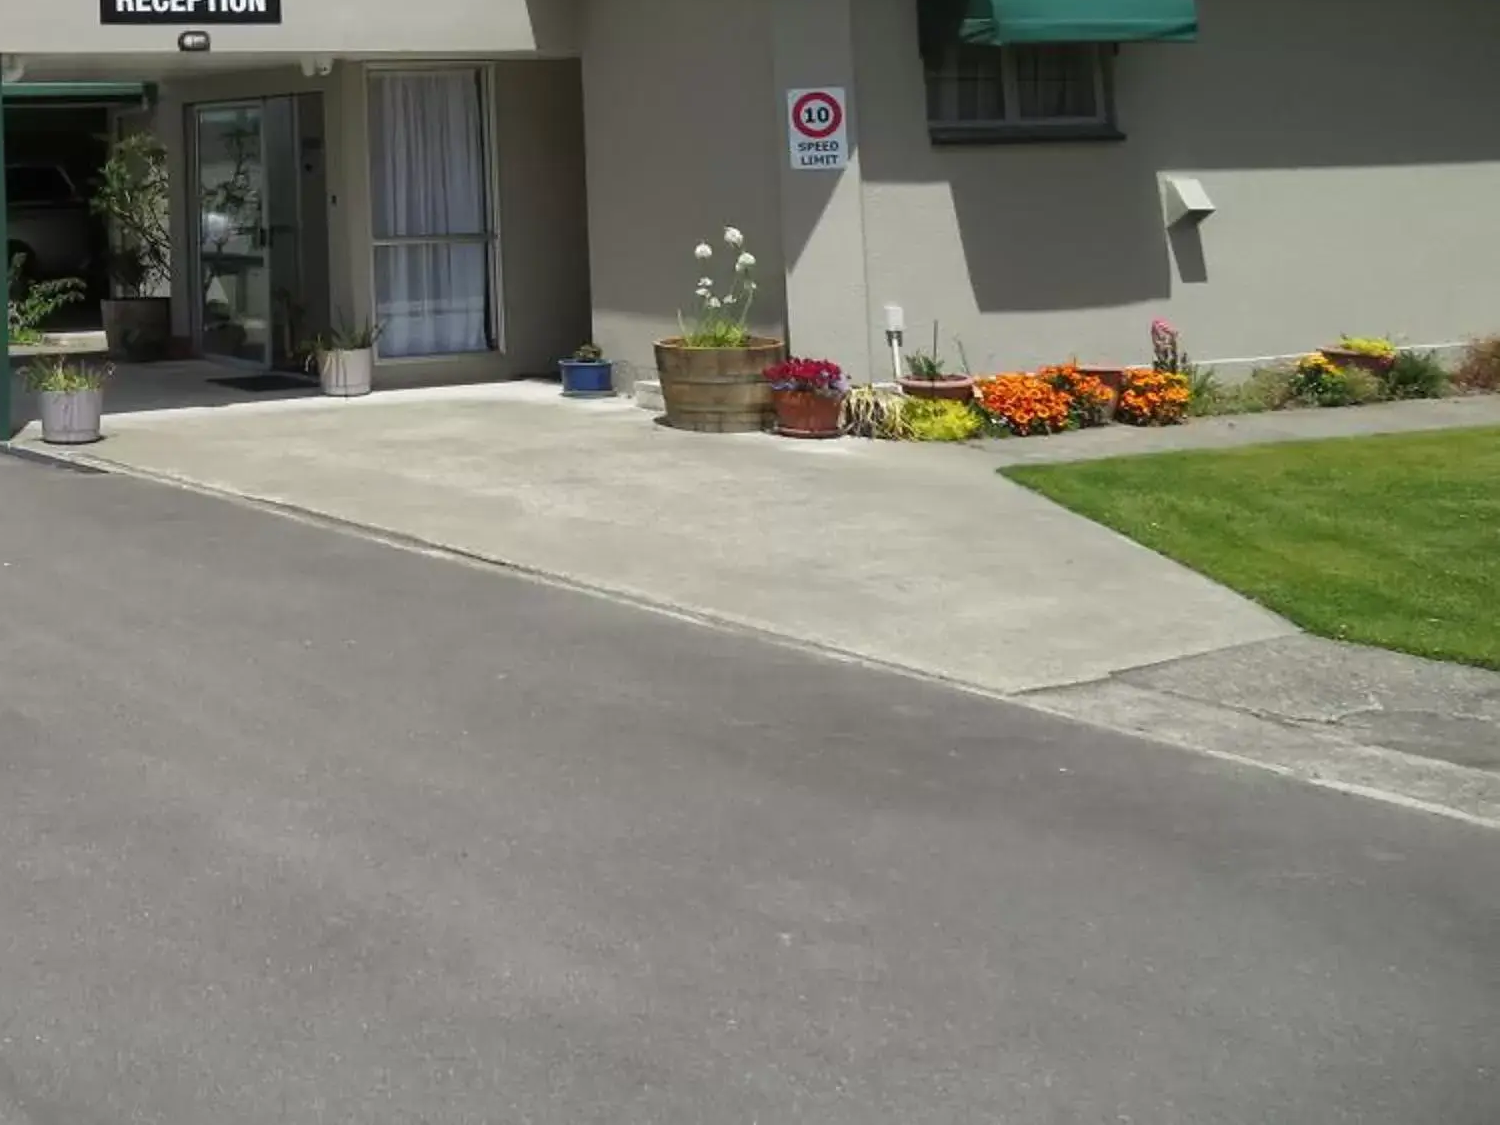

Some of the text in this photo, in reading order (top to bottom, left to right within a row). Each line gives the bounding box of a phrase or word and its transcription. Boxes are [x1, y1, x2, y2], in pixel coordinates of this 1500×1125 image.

[804, 106, 830, 124] 10
[797, 140, 840, 152] SPEED
[800, 154, 839, 166] LIMIT
